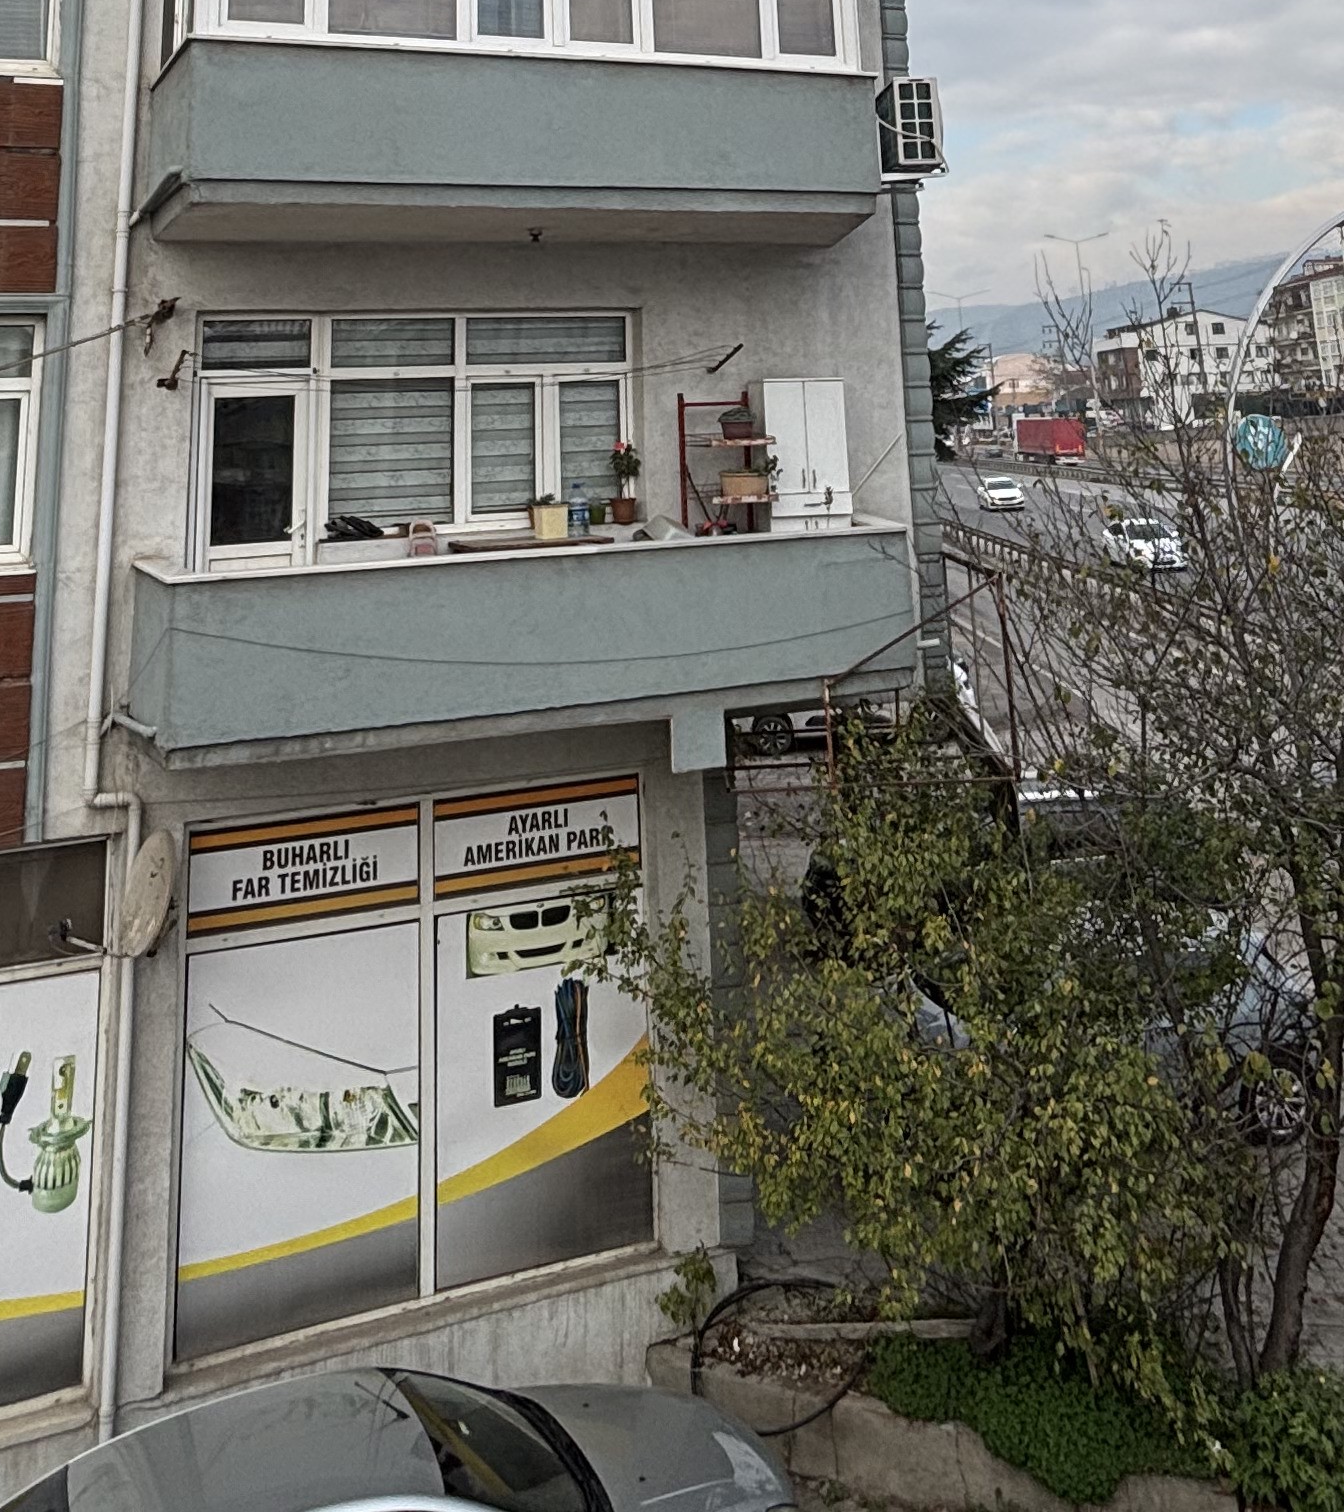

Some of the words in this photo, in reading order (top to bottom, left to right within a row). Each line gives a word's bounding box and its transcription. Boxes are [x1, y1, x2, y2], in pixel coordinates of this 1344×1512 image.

[508, 808, 569, 836] AYARLI
[262, 839, 350, 871] BUHARLI
[463, 832, 560, 867] AMERİKAN
[232, 876, 270, 901] FAR
[277, 855, 378, 894] TEMİZLİĞİ
